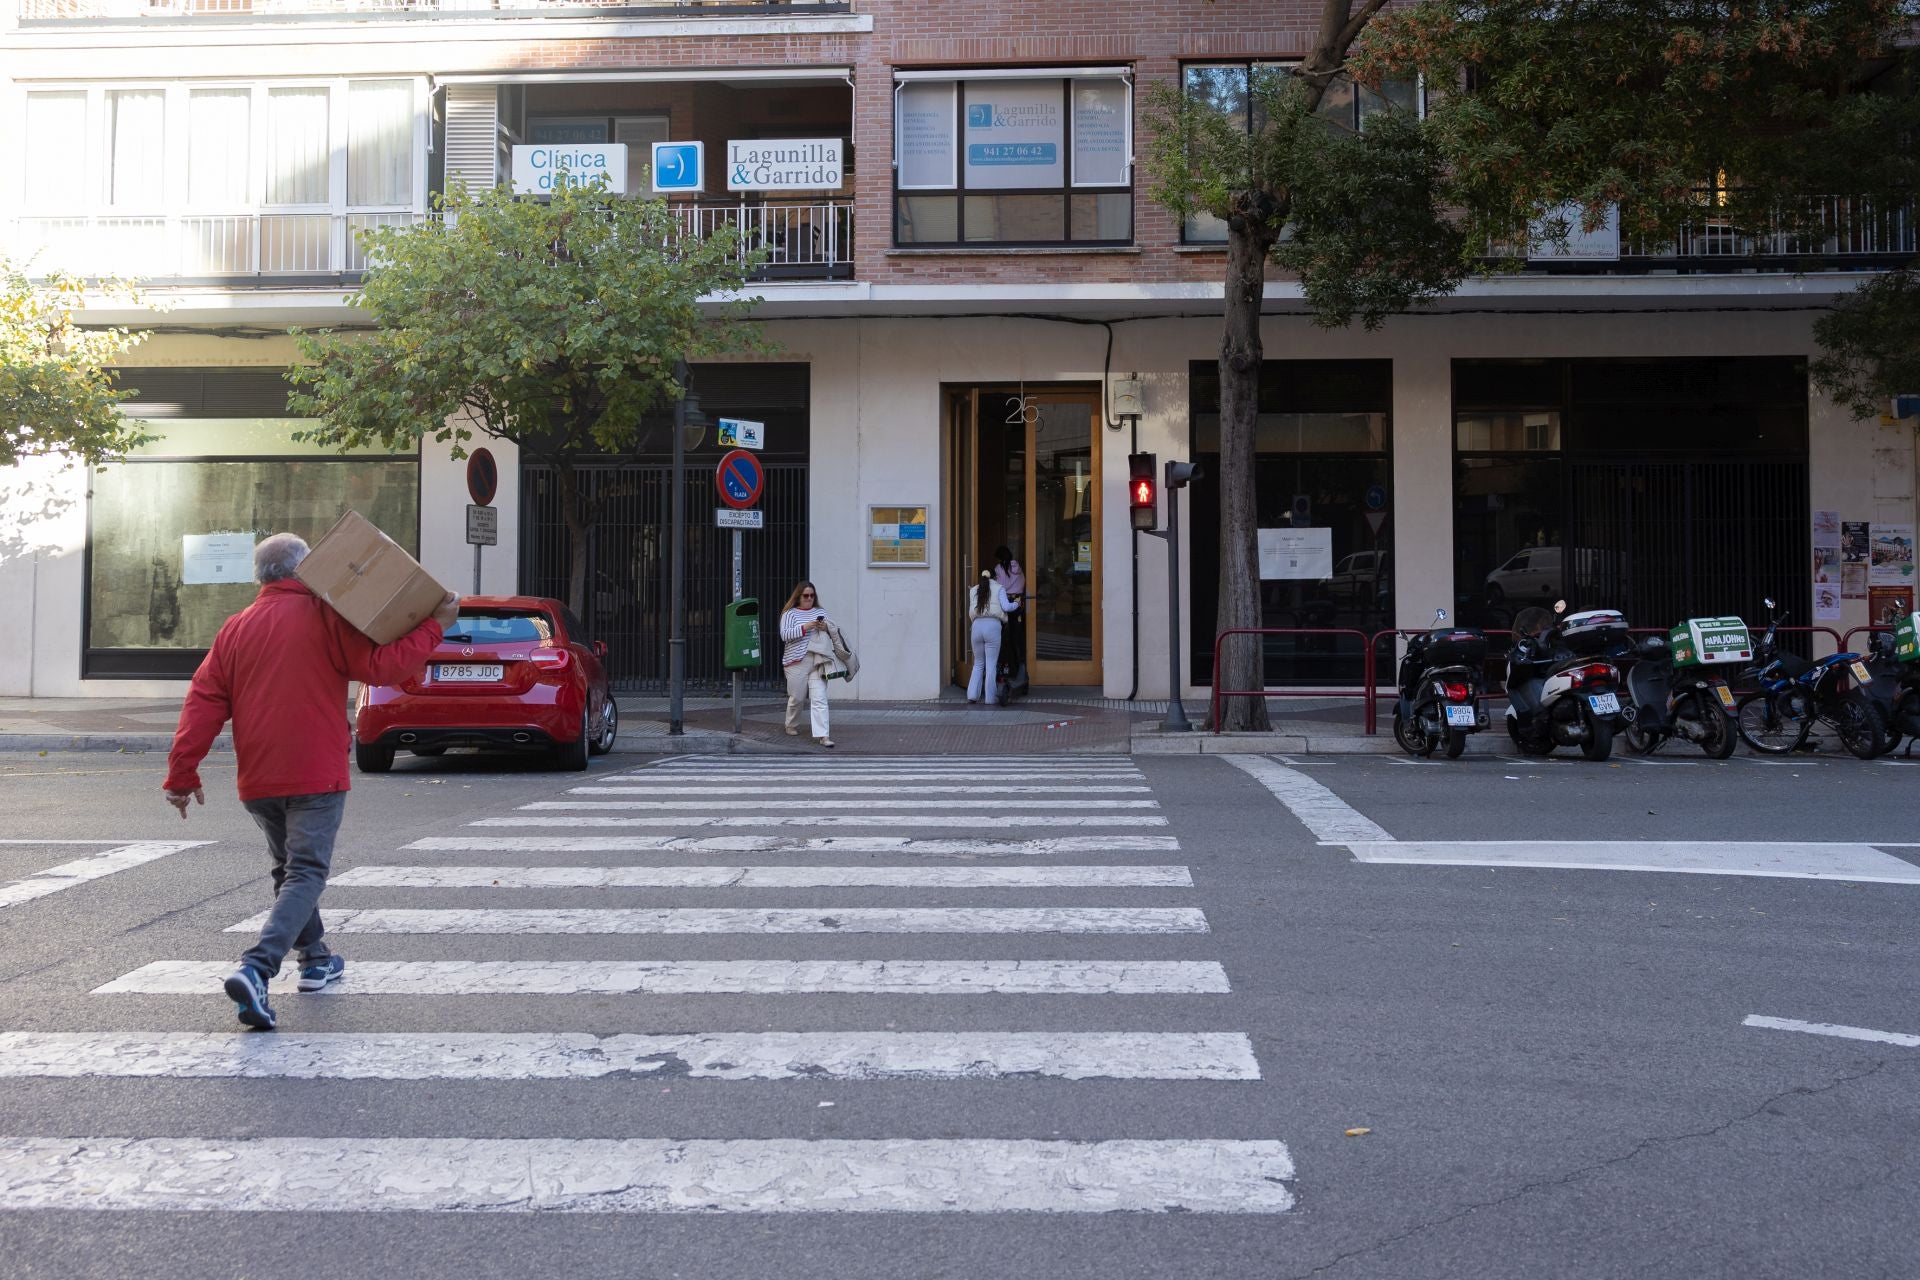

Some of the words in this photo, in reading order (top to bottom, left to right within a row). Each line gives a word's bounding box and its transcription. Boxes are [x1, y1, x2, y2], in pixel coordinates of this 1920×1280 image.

[994, 103, 1056, 116] Lagunilla
[732, 144, 837, 168] Lagunilla
[983, 146, 999, 156] 941
[1002, 146, 1014, 156] 27
[1017, 146, 1028, 155] 06
[1031, 146, 1042, 155] 42
[531, 149, 607, 169] Clínica
[731, 163, 838, 184] &Garrido
[1005, 396, 1039, 424] 25
[728, 511, 751, 519] EXCEPTO
[719, 518, 760, 526] DISCAPACITADOS
[442, 666, 473, 677] 8785
[477, 666, 500, 677] JDC
